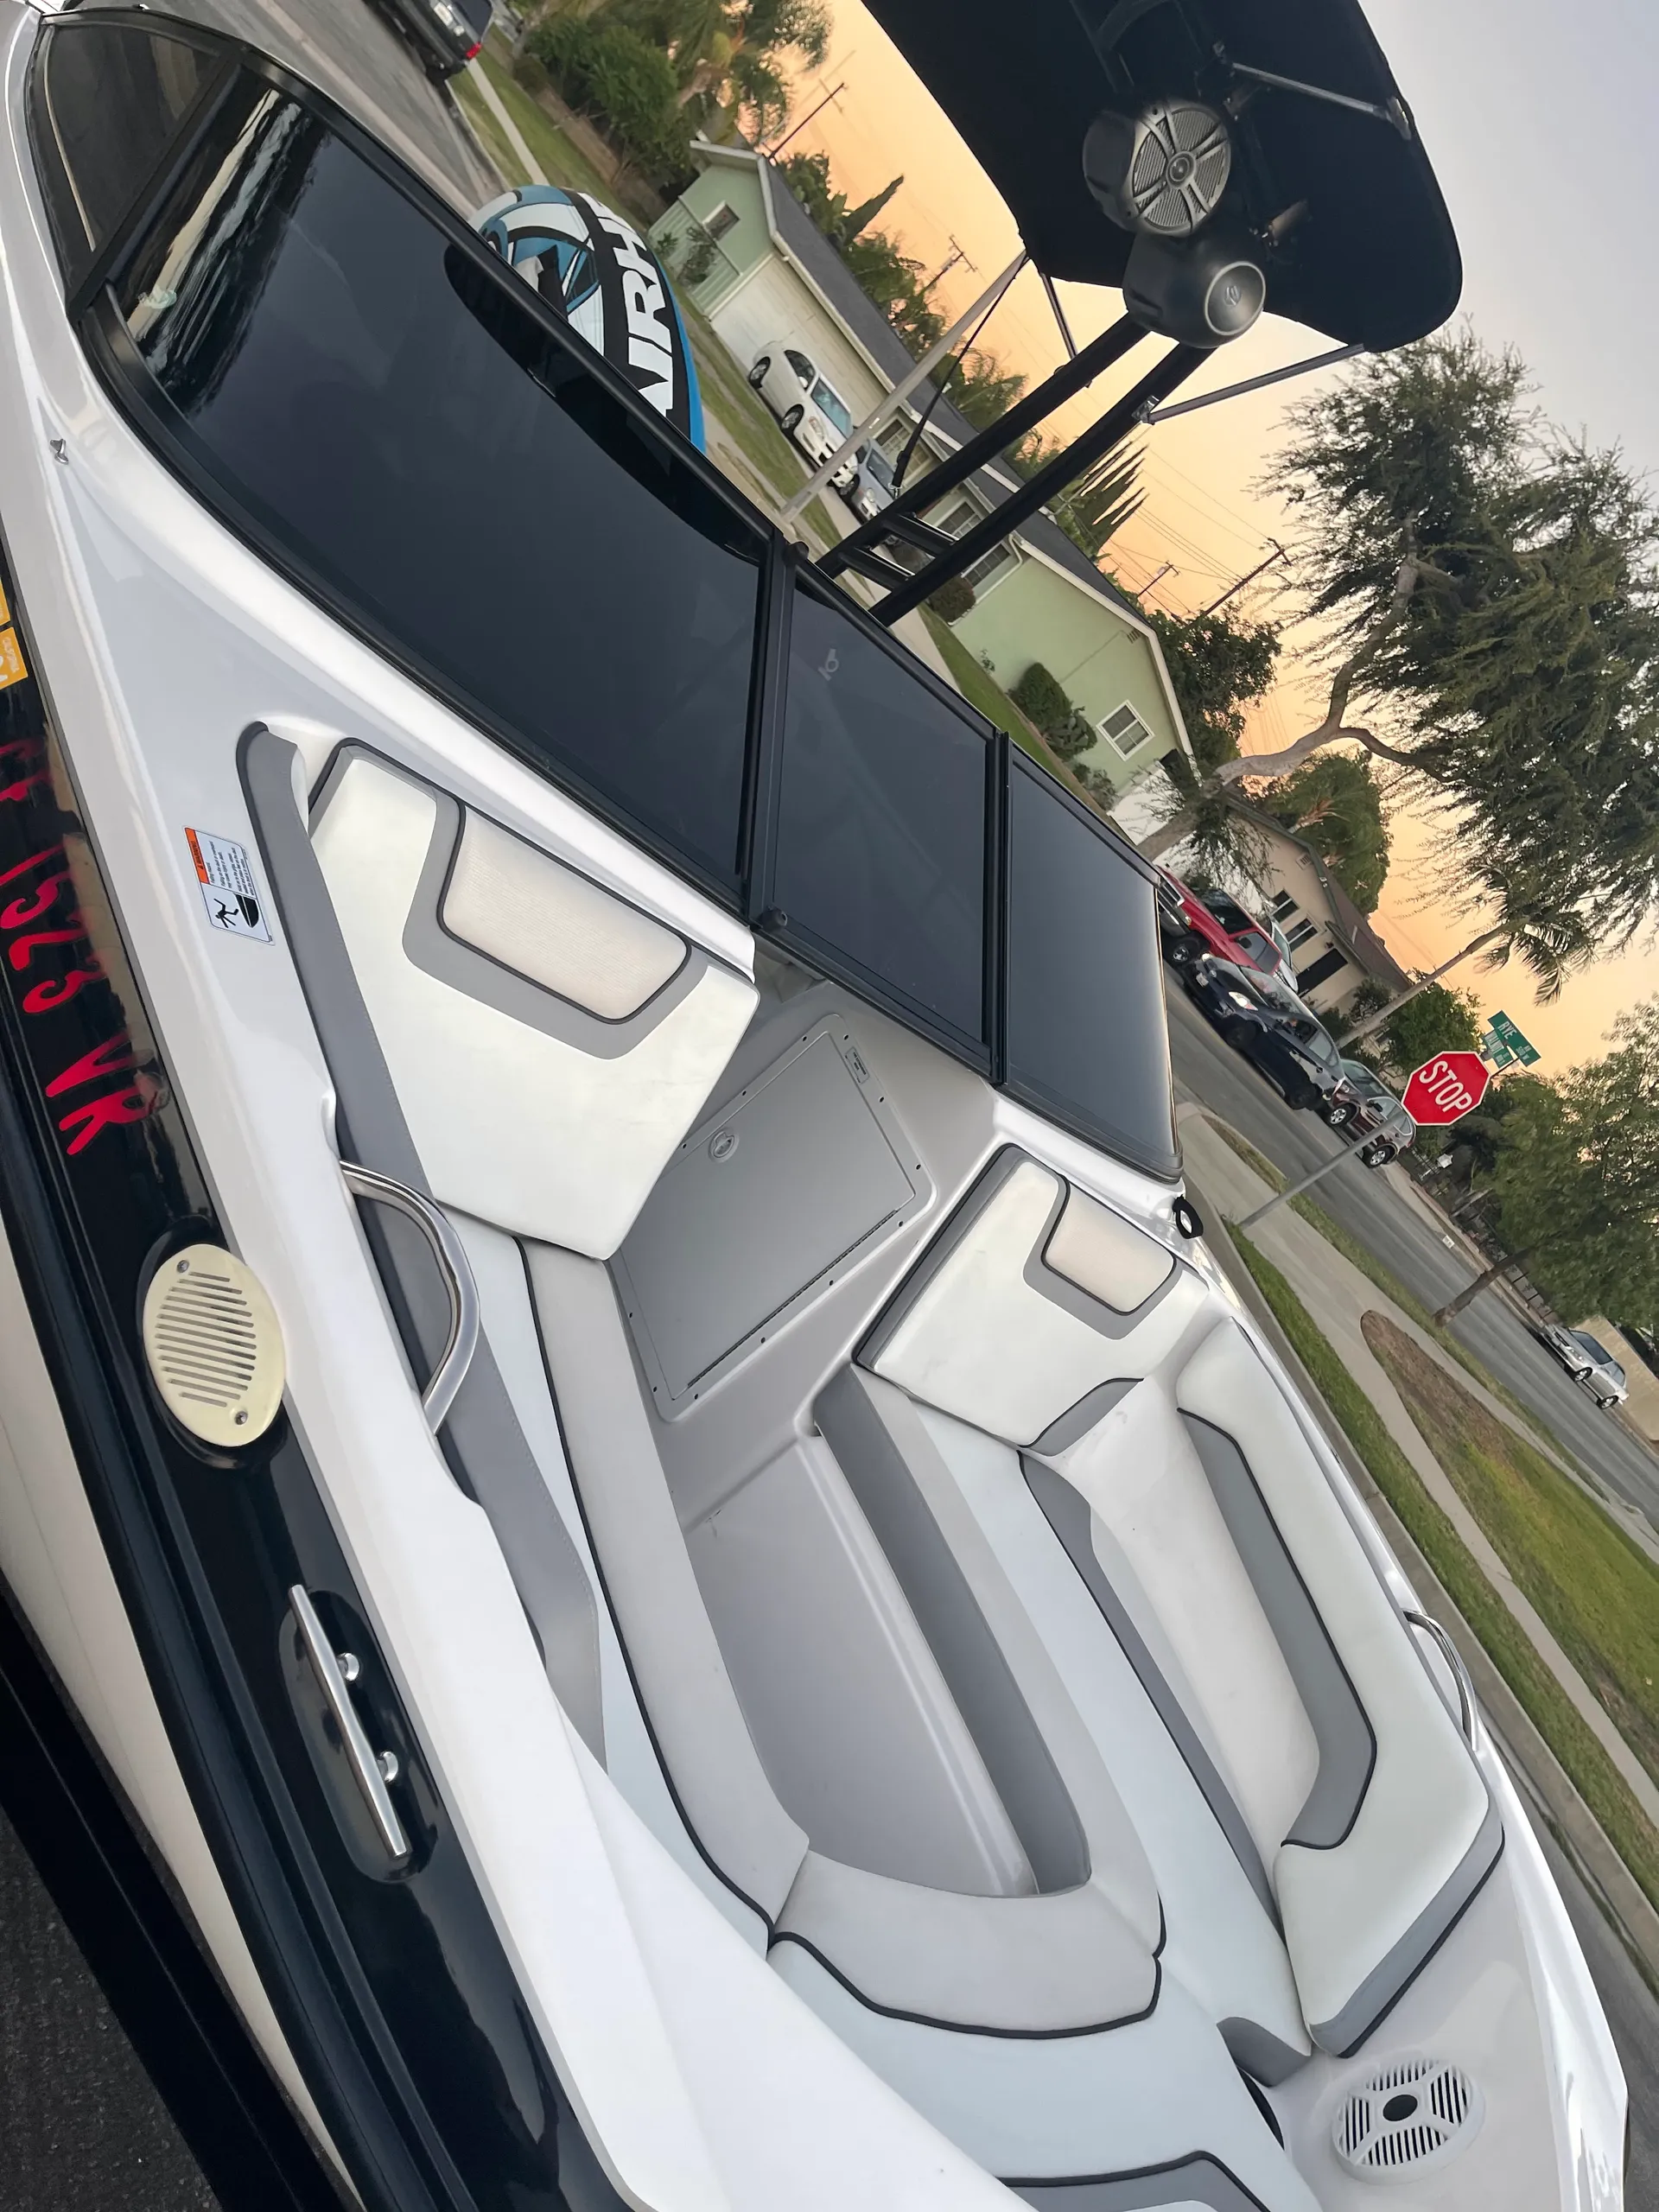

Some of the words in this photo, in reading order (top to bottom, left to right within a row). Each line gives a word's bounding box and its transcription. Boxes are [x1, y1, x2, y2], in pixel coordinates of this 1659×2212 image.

[1497, 1021, 1517, 1039] RYE
[45, 1026, 169, 1155] VR
[1419, 1060, 1472, 1113] STOP
